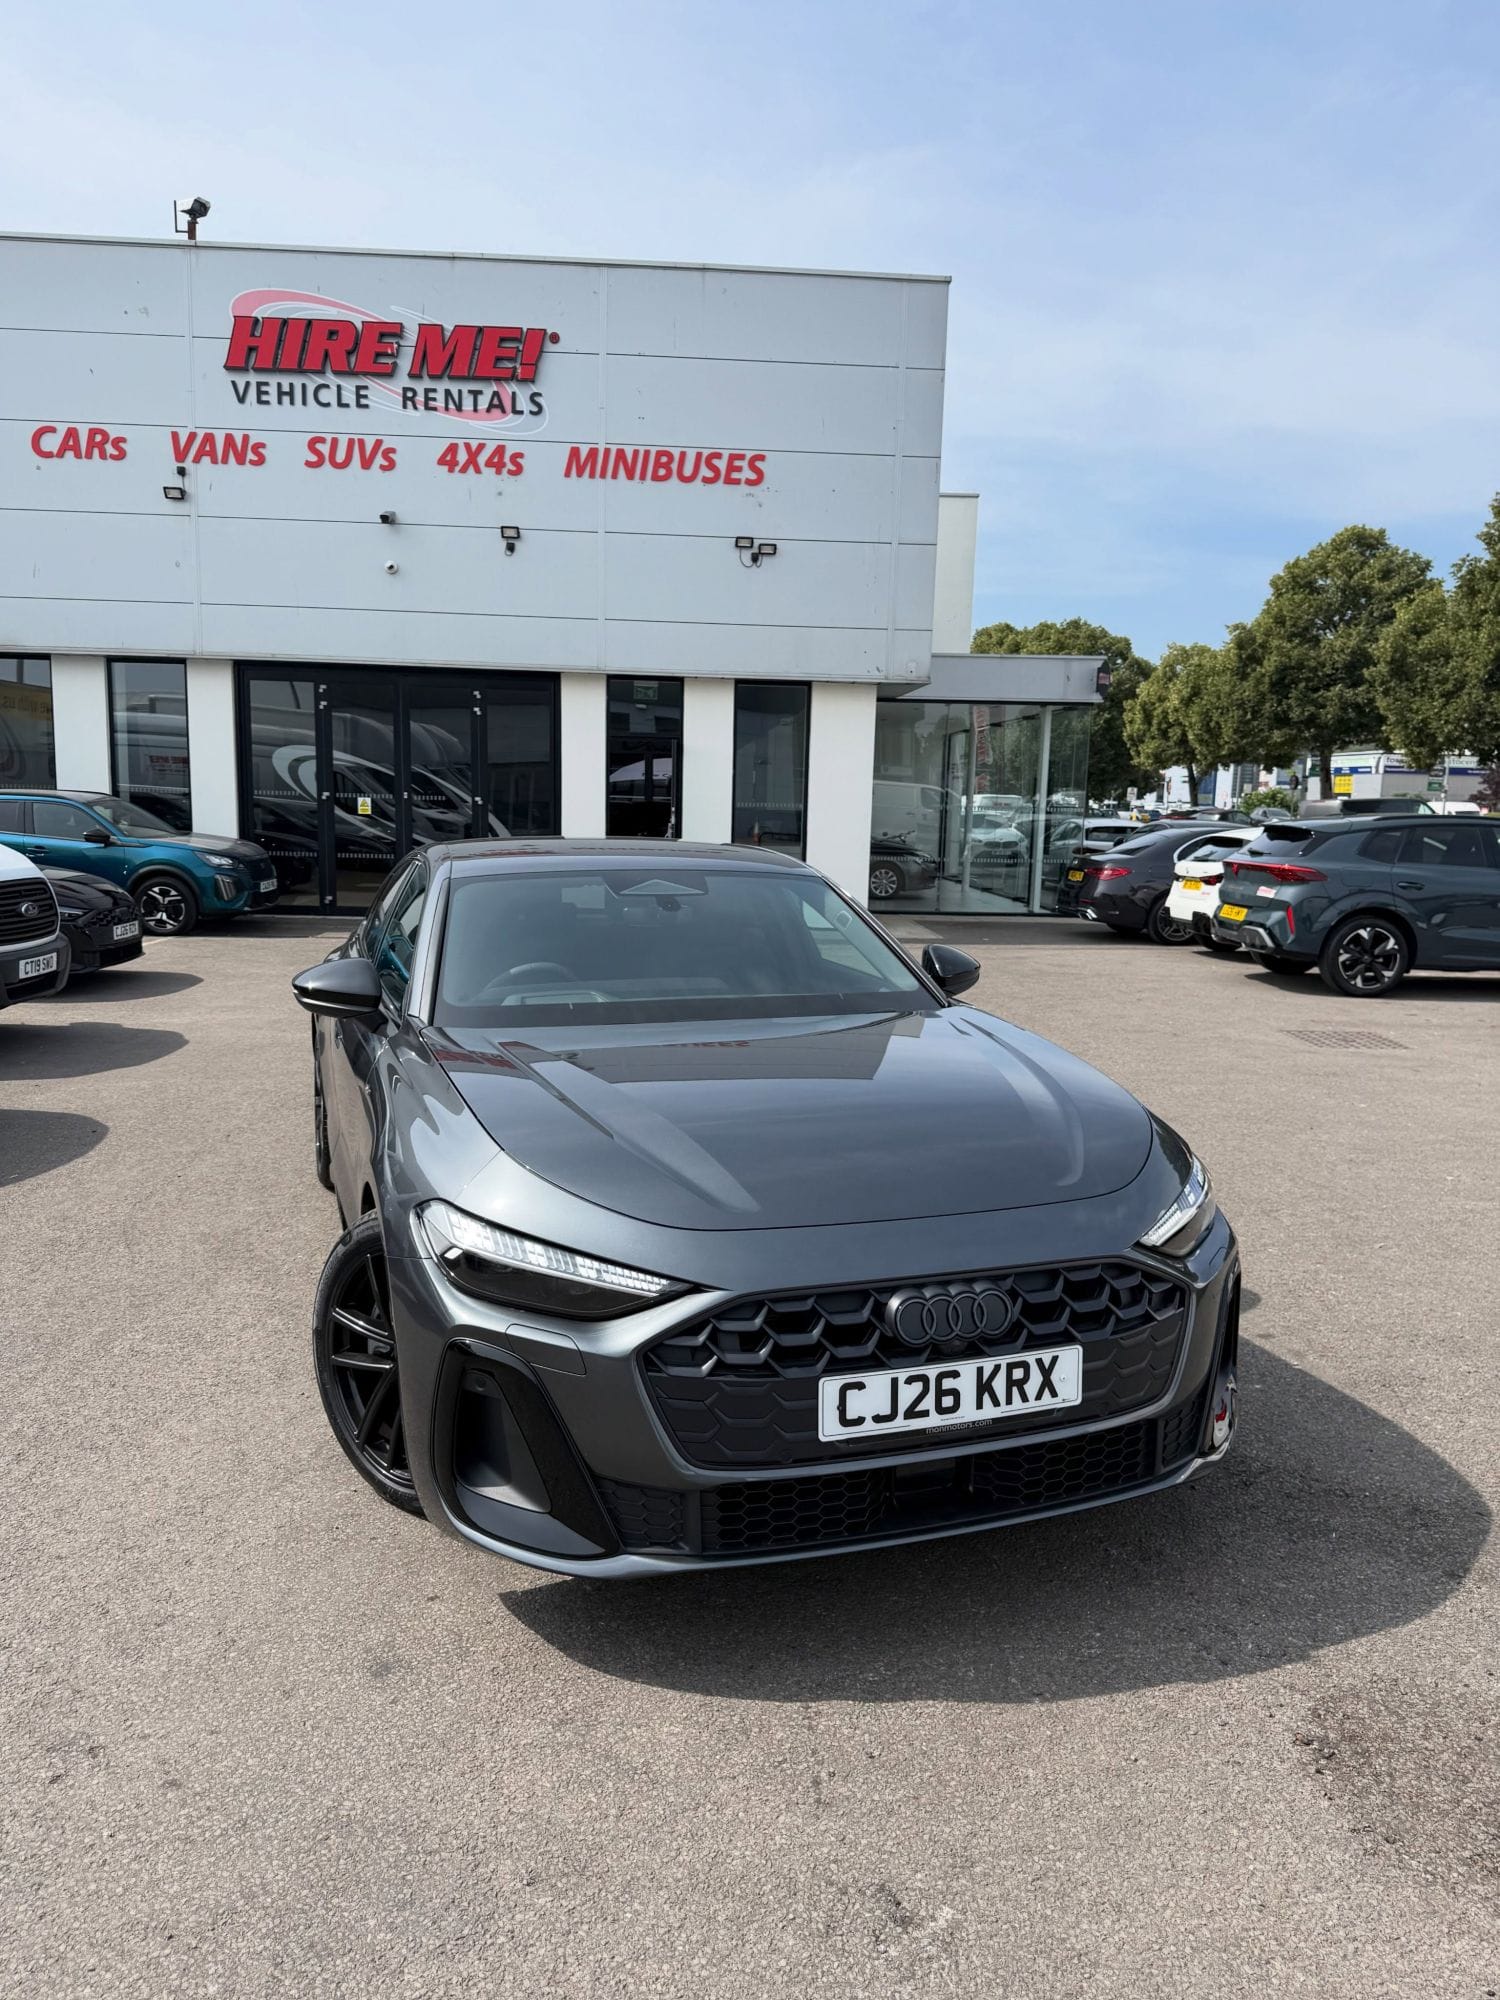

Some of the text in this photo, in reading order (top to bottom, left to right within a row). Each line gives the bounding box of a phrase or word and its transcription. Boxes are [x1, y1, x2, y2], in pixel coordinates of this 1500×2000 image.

[223, 315, 403, 377] HIRE
[231, 380, 543, 416] VEHICLE RENTALS
[31, 425, 767, 486] CARs VANs SUVs 4X4s MINIBUSES
[24, 959, 41, 975] CT19
[837, 1354, 1060, 1428] CJ26 KRX
[926, 1419, 993, 1434] monmotors.com
